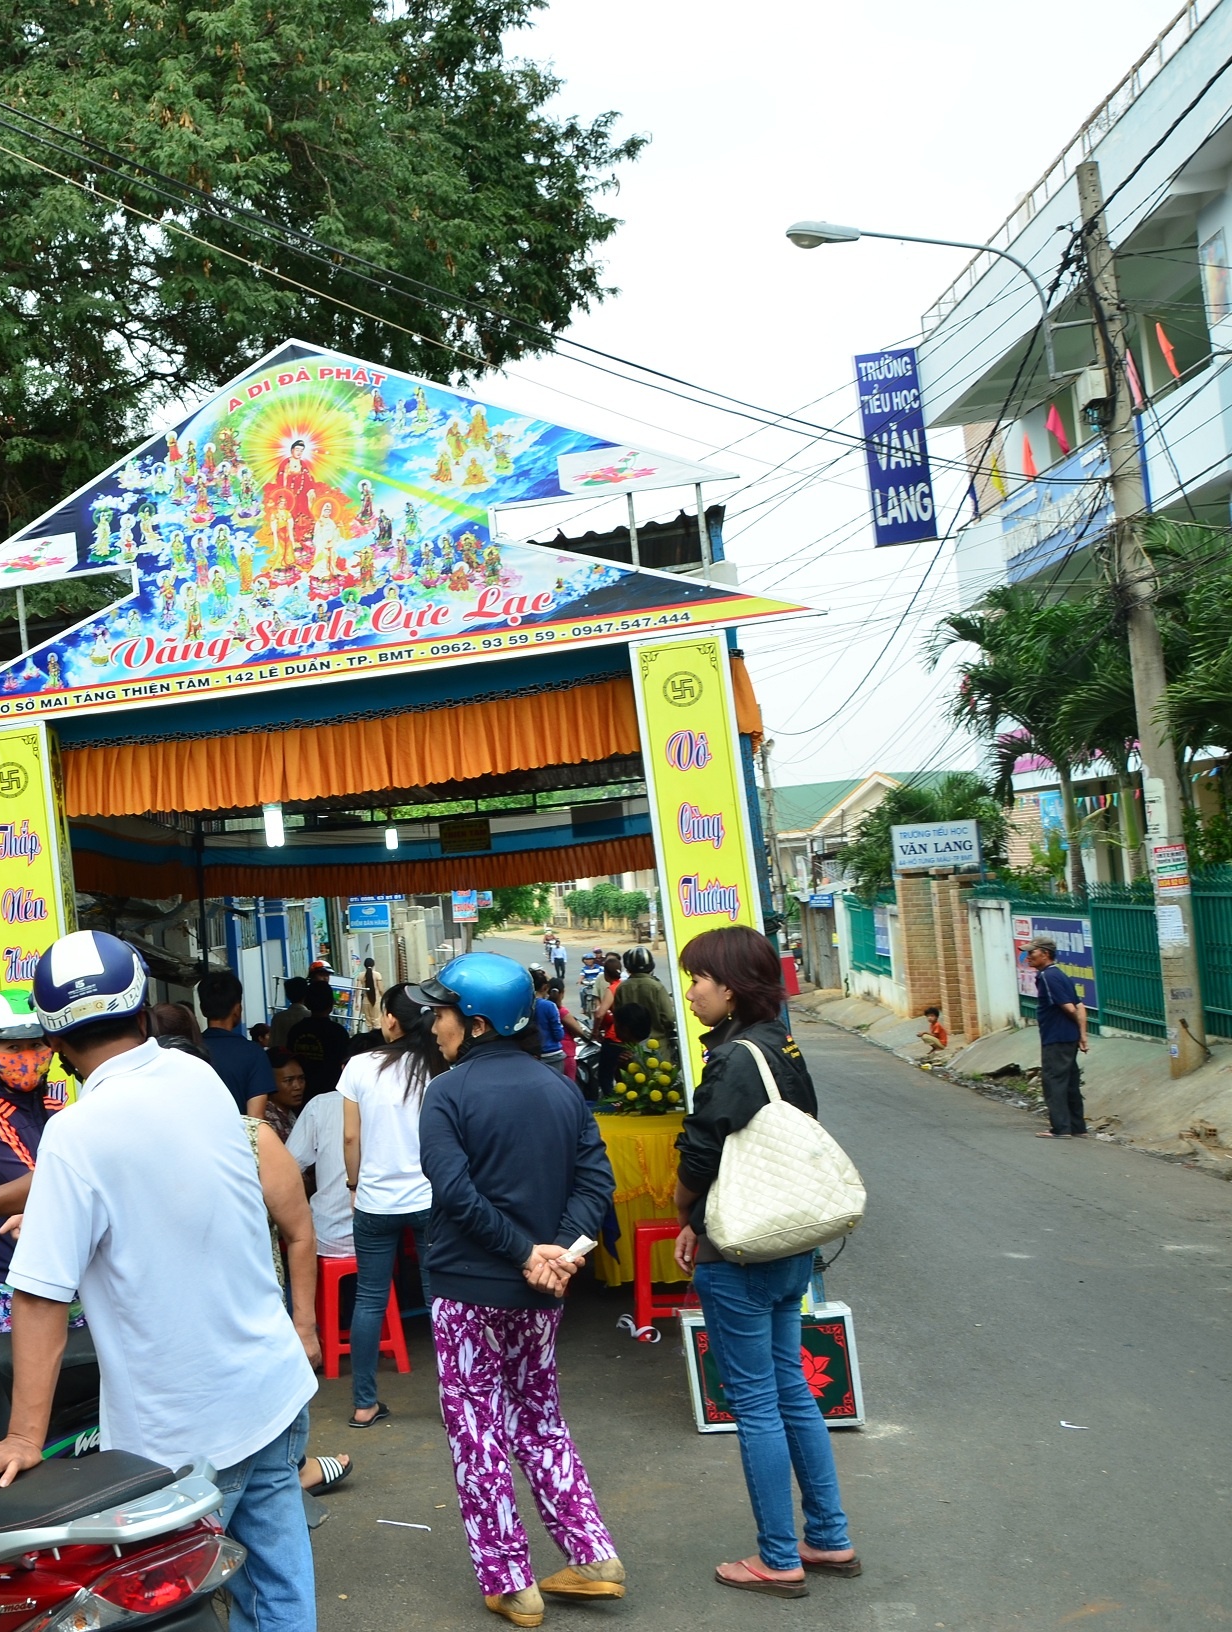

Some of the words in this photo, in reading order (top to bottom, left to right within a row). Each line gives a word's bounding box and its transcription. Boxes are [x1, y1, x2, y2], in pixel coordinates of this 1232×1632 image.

[859, 354, 912, 381] TRƯỜNG
[228, 397, 243, 413] A
[248, 380, 271, 399] DI
[278, 368, 311, 386] ĐÀ
[319, 368, 387, 386] PHẬT
[861, 384, 891, 415] TIỂU
[893, 389, 920, 414] HỌC
[873, 422, 922, 471] VĂN
[875, 483, 933, 527] LANG
[110, 636, 234, 669] Vãng
[245, 609, 359, 652] Sanh
[372, 600, 452, 638] Cực
[463, 586, 553, 627] Lạc
[15, 697, 35, 711] SỞ
[40, 696, 68, 709] MAI
[73, 690, 116, 704] TÁNG
[121, 682, 171, 697] THIỆN
[176, 676, 211, 690] TÂM
[226, 672, 254, 684] 142
[259, 666, 279, 680] LÊ
[346, 655, 373, 667] TP.
[378, 648, 415, 663] BMT
[430, 642, 477, 655] 0962.
[481, 637, 503, 649] 93
[508, 633, 529, 645] 59
[535, 630, 555, 642] 59
[571, 611, 692, 637] 0947.547.444
[665, 729, 713, 771] Vô
[899, 841, 927, 856] VĂN
[933, 840, 974, 854] LANG
[0, 886, 49, 925] Nén
